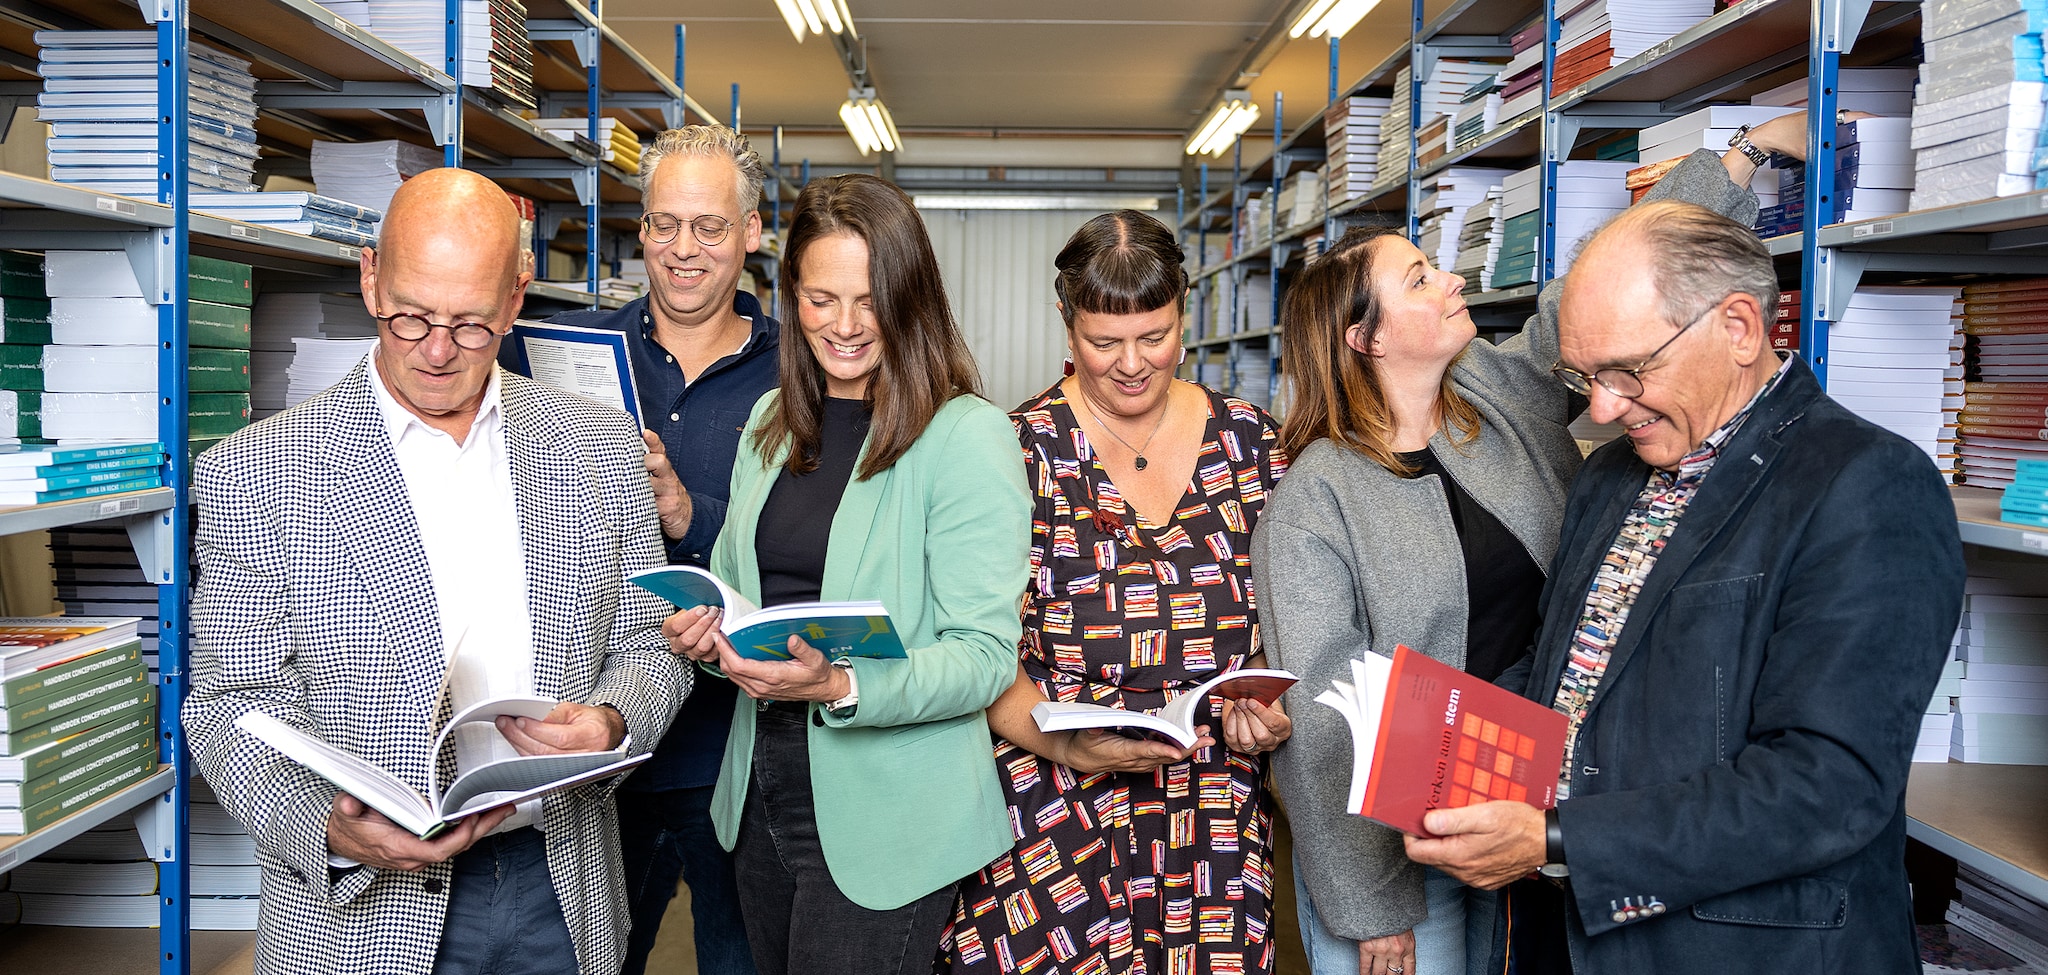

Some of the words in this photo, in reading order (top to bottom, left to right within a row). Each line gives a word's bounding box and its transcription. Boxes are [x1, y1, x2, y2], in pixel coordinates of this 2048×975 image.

[1774, 338, 1788, 346] stem
[1779, 323, 1792, 332] stem
[830, 645, 853, 653] EN
[43, 670, 72, 687] HANDBOEK
[72, 654, 126, 677] CONCEPTONTWIKKELING
[48, 695, 77, 711] HANDBOEK
[77, 676, 132, 700] CONCEPTONTWIKKELING
[1445, 688, 1461, 726] stem
[50, 718, 80, 734] HANDBOEK
[80, 698, 139, 723] CONCEPTONTWIKKELING
[62, 740, 88, 758] HANDBOEK
[88, 720, 140, 746] CONCEPTONTWIKKELING
[1441, 730, 1452, 758] aan
[59, 767, 86, 784] HANDBOEK
[86, 743, 139, 772] CONCEPTONTWIKKELING
[62, 791, 89, 809] HANDBOEK
[89, 766, 142, 796] CONCEPTONTWIKKELING
